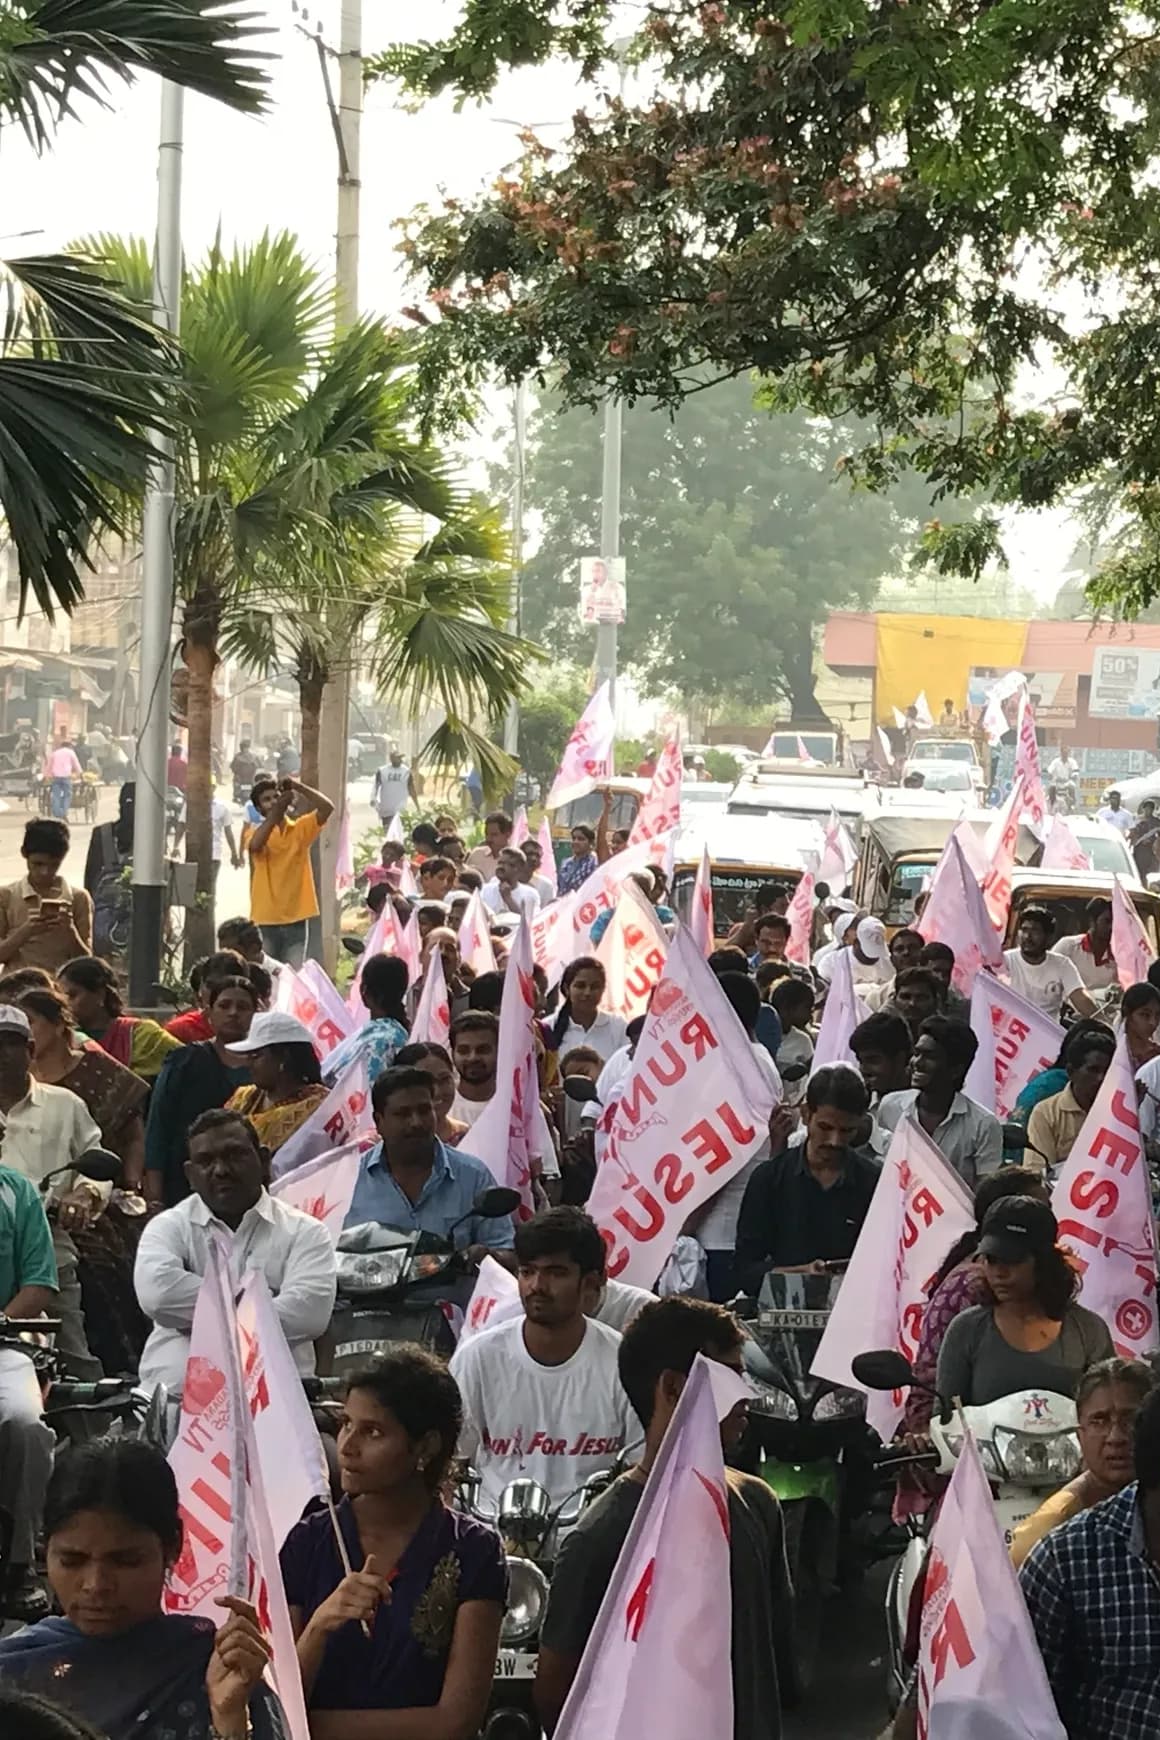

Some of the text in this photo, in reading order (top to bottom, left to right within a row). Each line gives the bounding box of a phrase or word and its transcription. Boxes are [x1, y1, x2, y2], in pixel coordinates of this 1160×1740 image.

[1103, 656, 1137, 673] 50%
[1057, 1089, 1141, 1280] JESU
[526, 1431, 568, 1456] FOR
